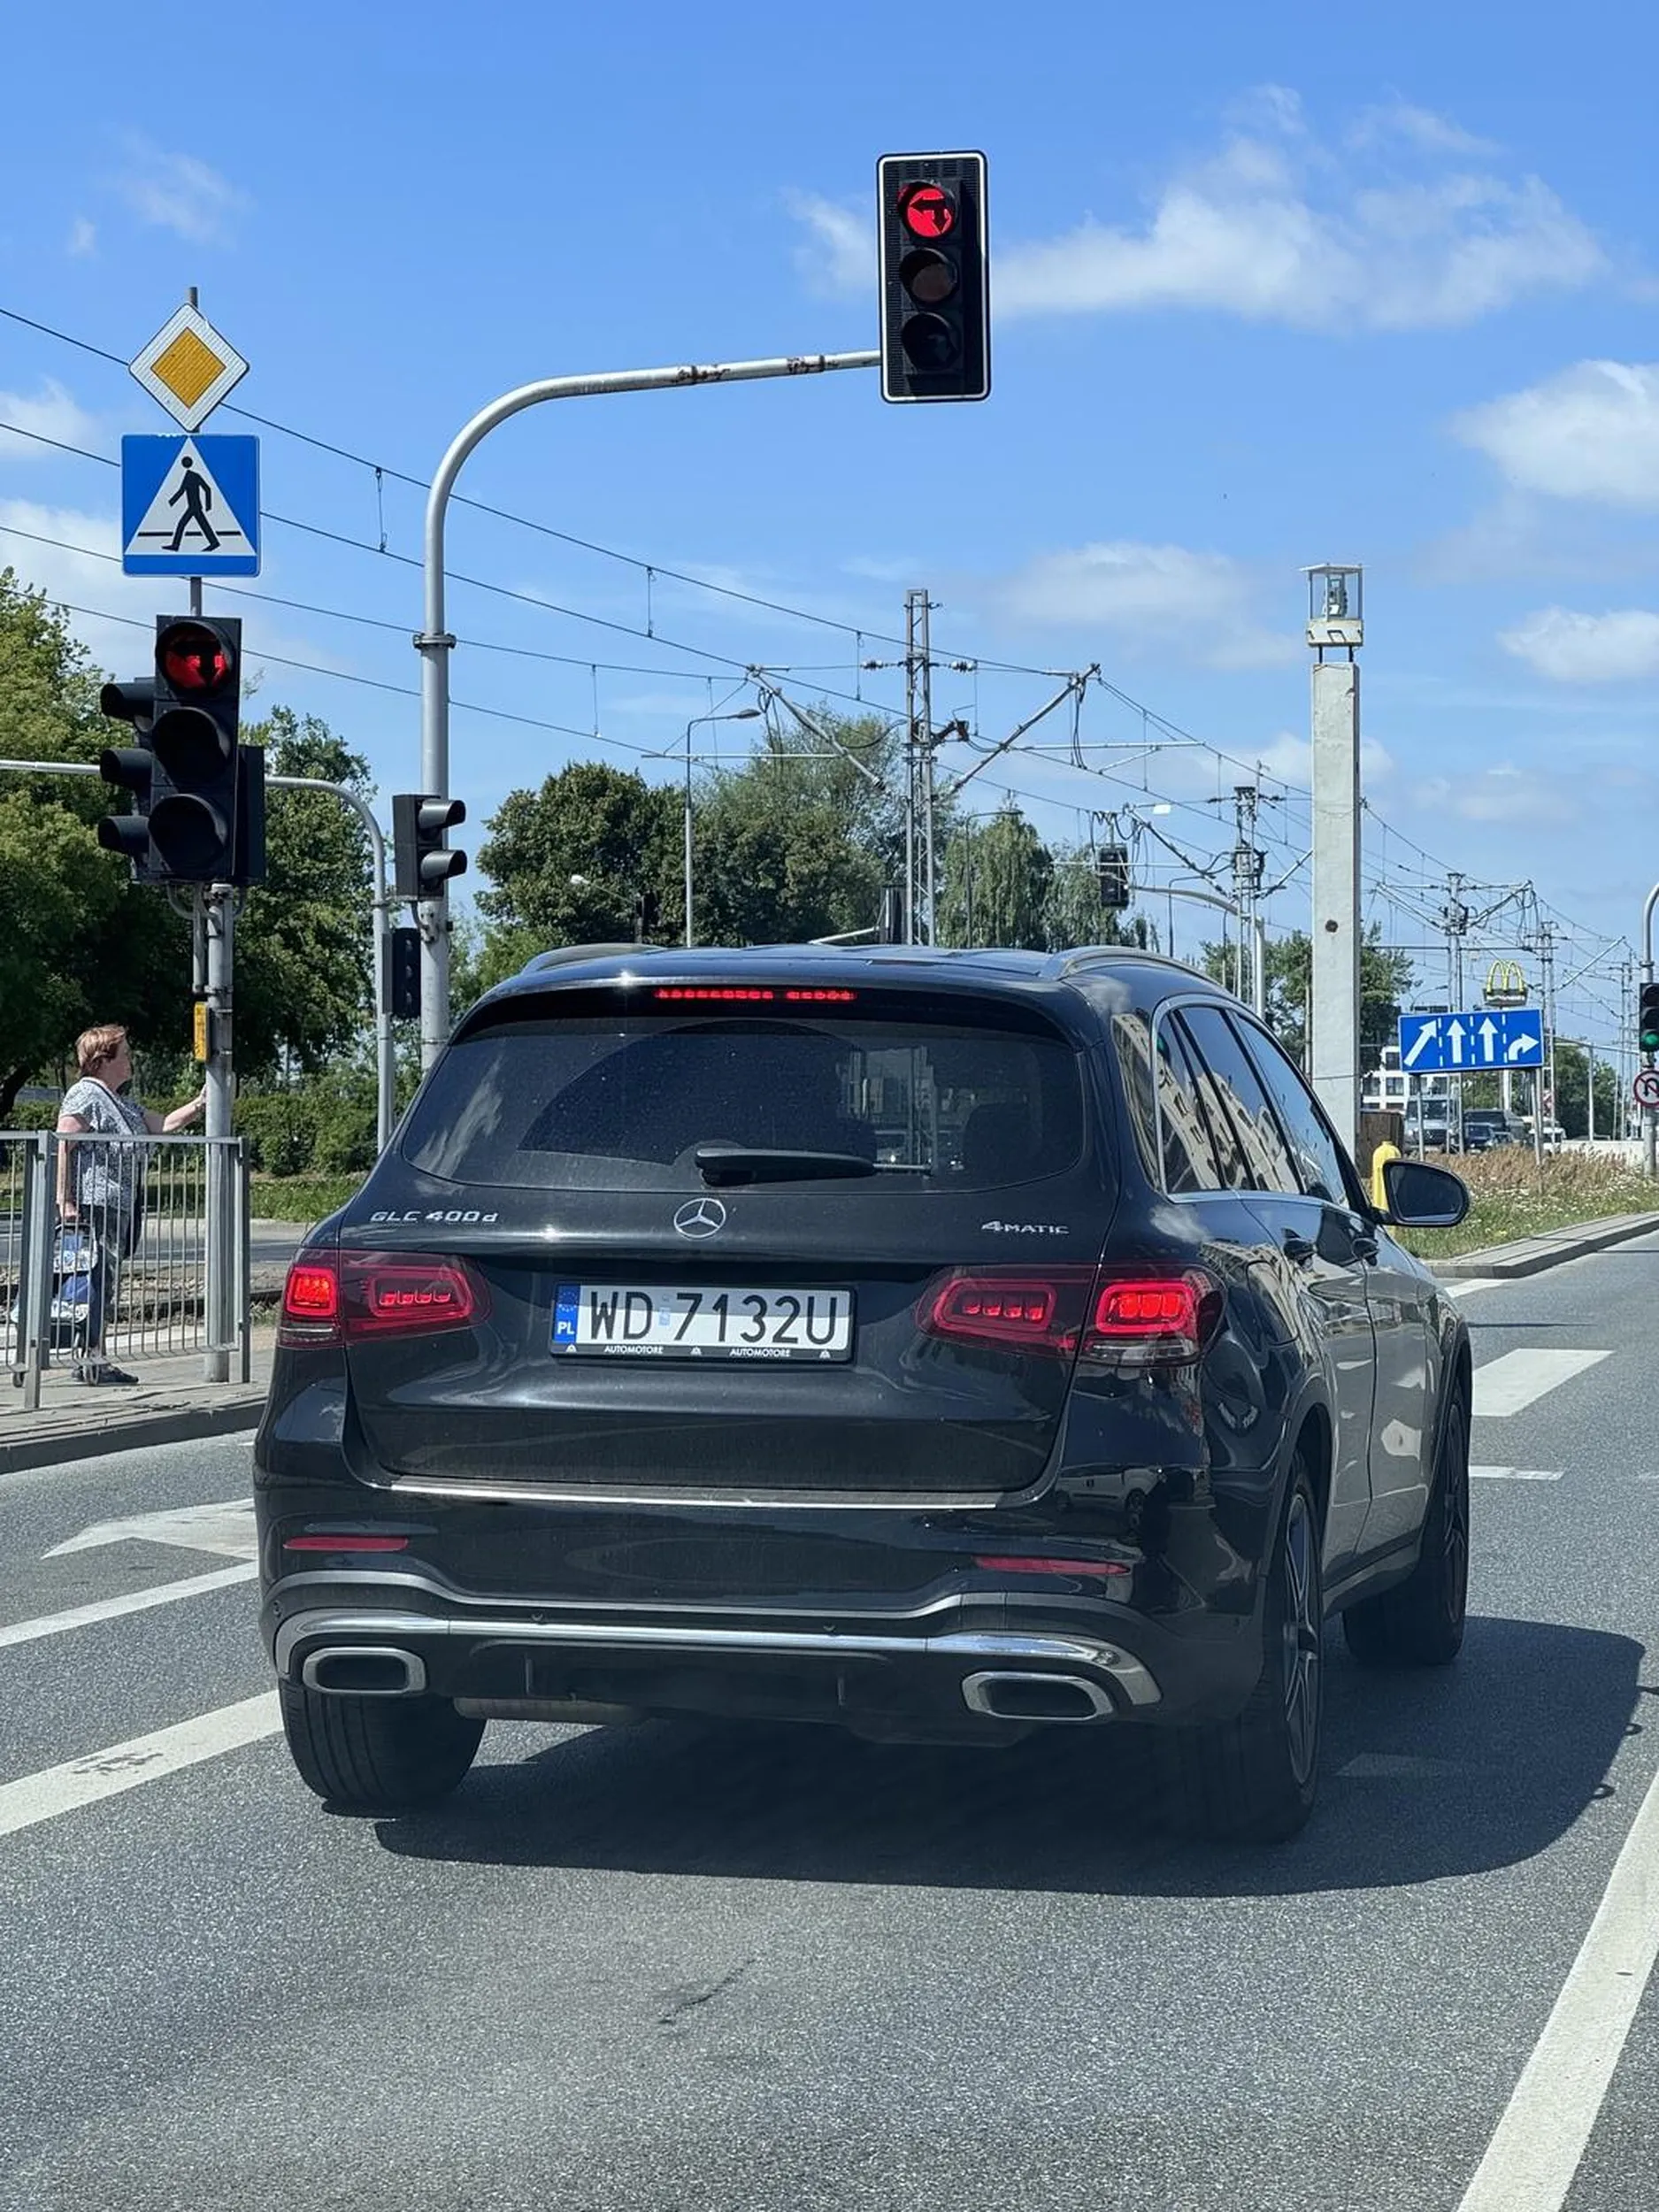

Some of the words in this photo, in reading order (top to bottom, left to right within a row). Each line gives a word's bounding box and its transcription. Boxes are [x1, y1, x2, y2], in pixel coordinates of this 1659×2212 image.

[370, 1210, 421, 1222] GLC
[981, 1220, 1070, 1234] 4MATIC
[590, 1291, 653, 1340] WD
[673, 1292, 837, 1345] 7132U
[557, 1321, 575, 1335] PL
[604, 1345, 664, 1355] AUTOMOTORE
[729, 1348, 792, 1358] AUTOMOTORE
